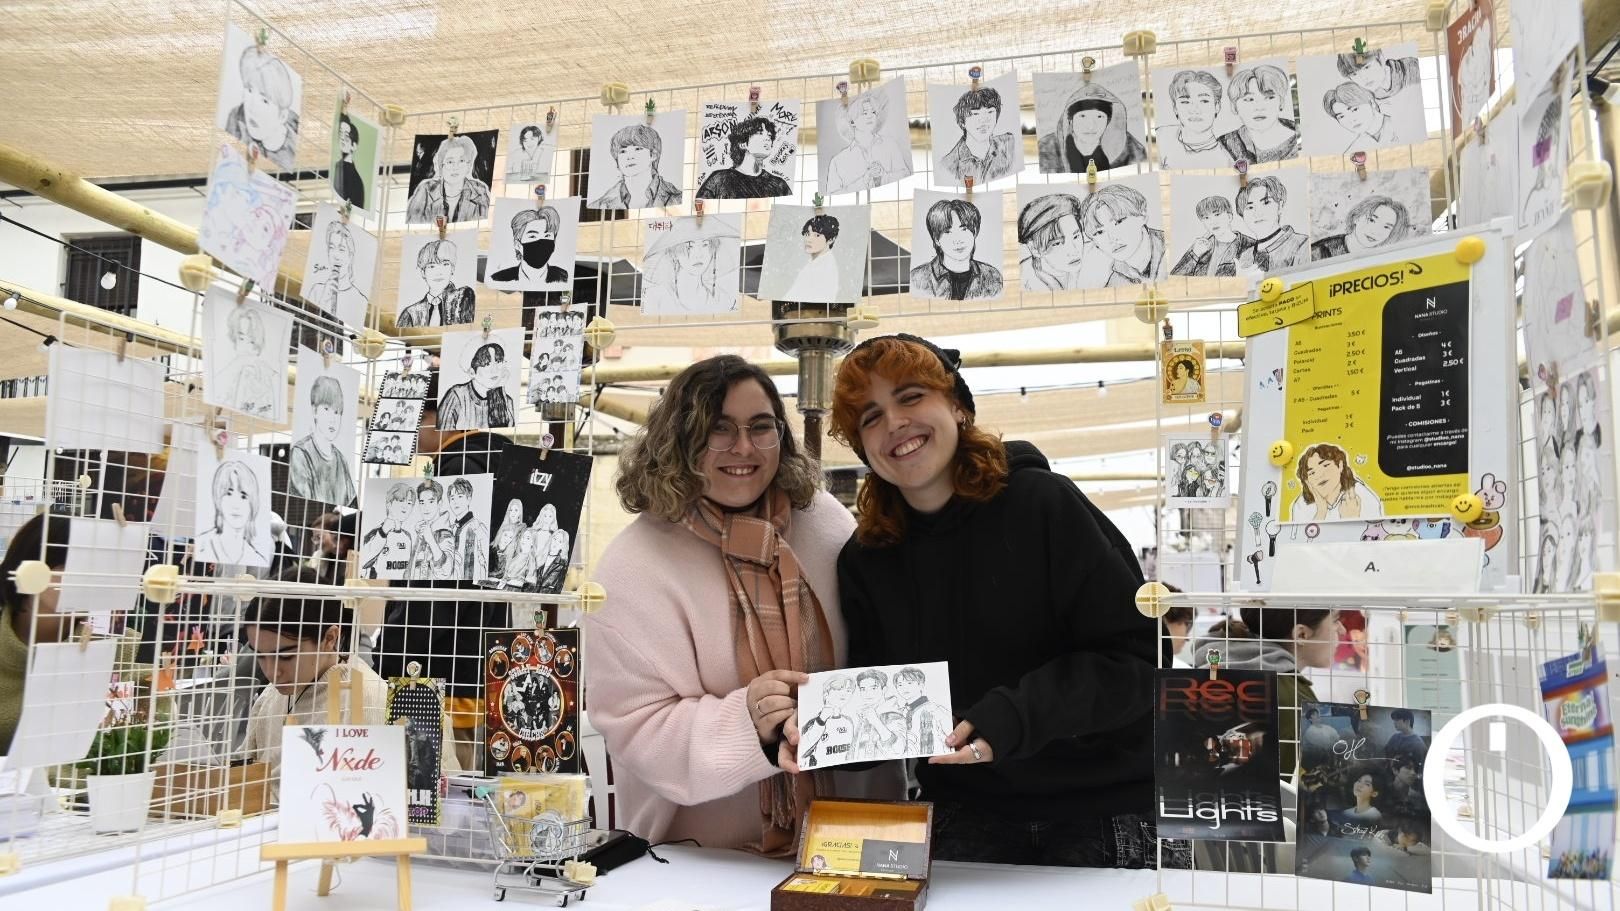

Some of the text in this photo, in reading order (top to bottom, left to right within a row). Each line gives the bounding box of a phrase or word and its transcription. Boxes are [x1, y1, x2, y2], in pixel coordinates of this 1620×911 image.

[771, 102, 798, 121] MORE
[1329, 270, 1404, 298] ¡PRECIOS!
[1311, 307, 1342, 320] PRINTS
[1408, 418, 1447, 427] COMISIONES
[1364, 561, 1380, 573] A.
[342, 728, 368, 737] LOVE
[316, 747, 384, 772] Nxde
[1160, 796, 1279, 830] Lights
